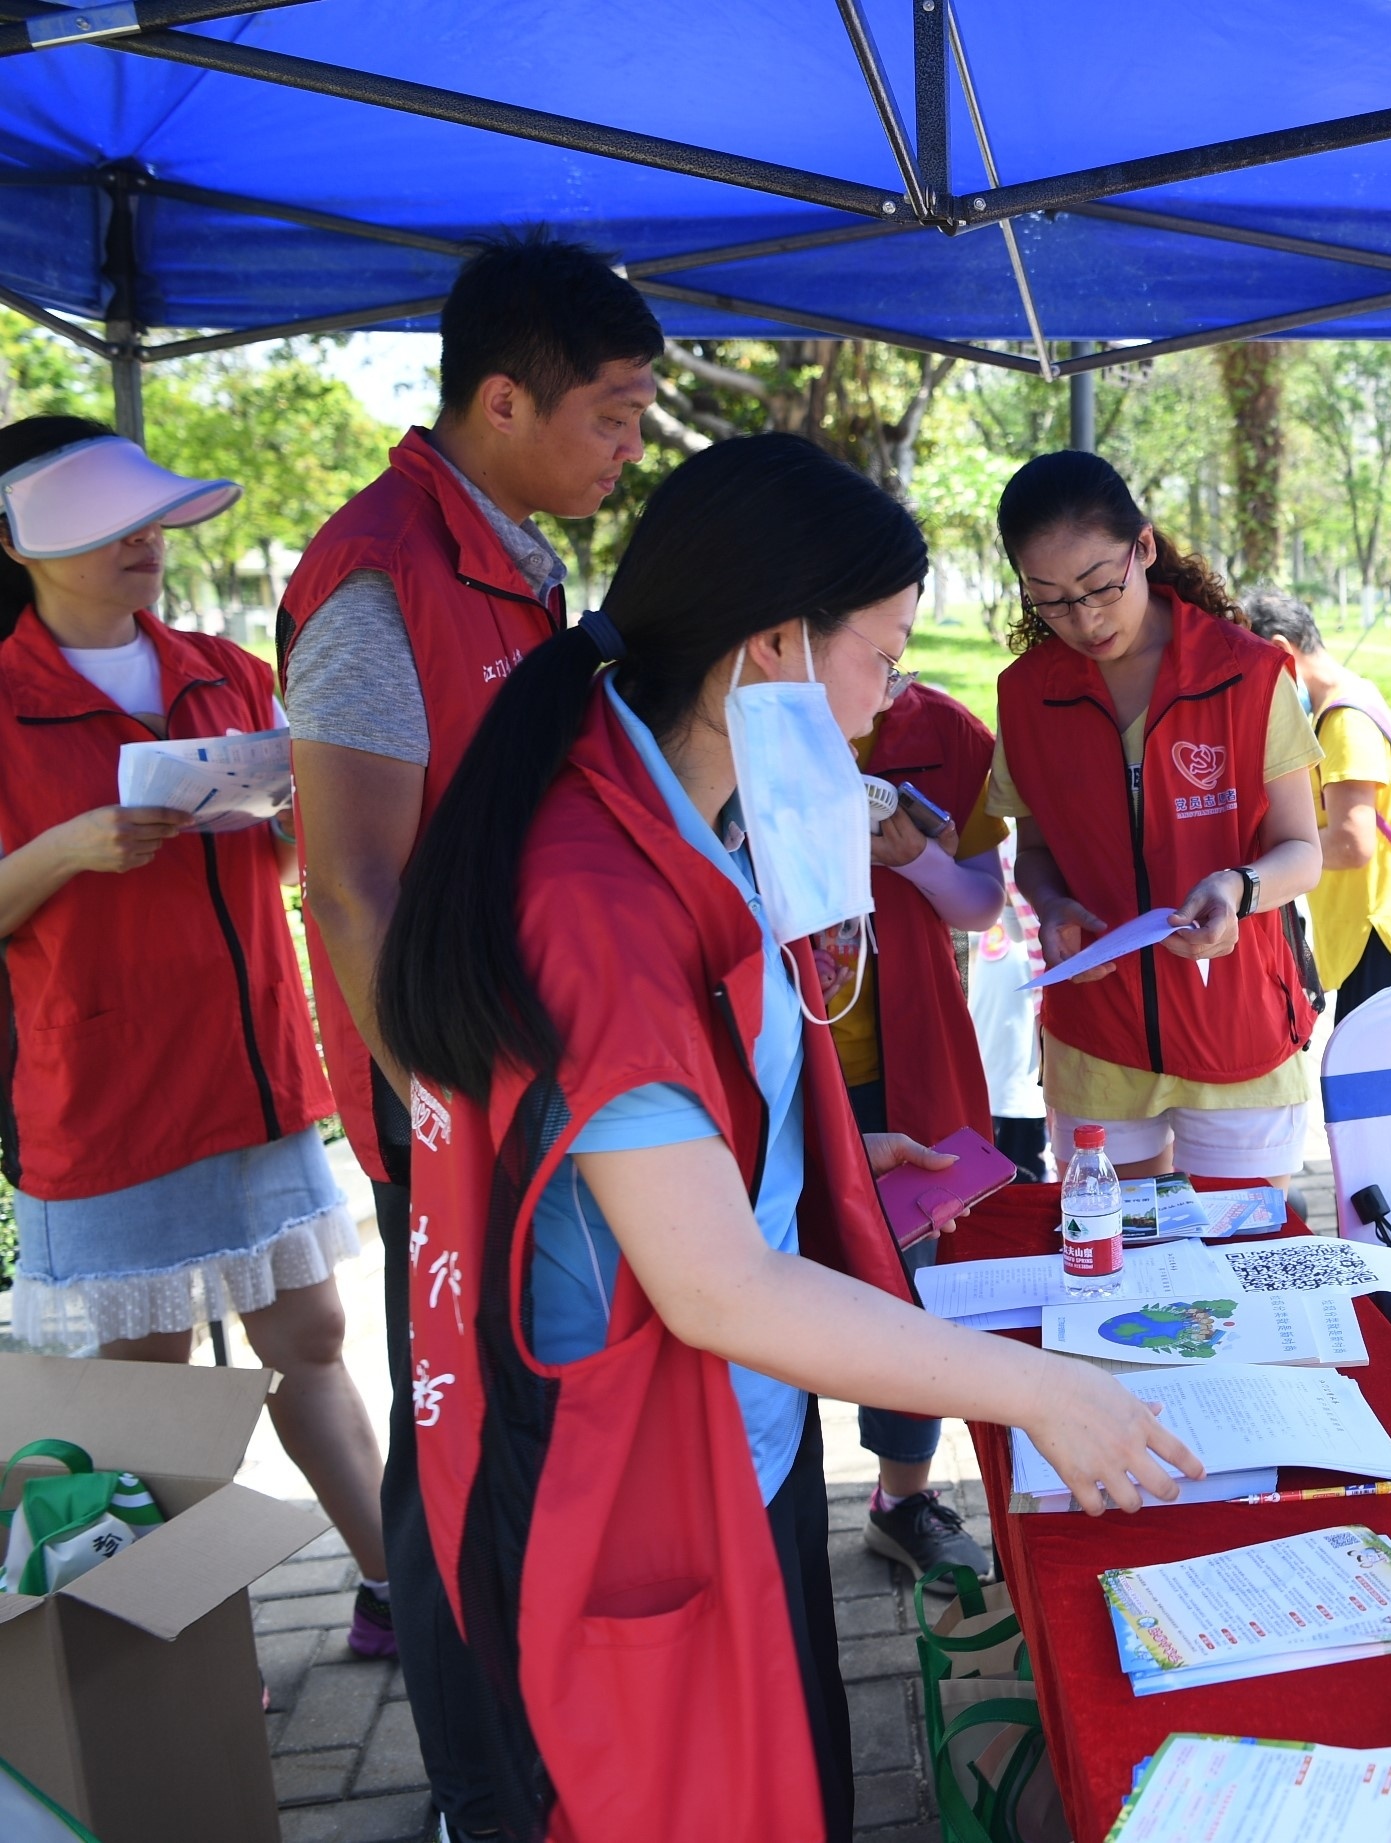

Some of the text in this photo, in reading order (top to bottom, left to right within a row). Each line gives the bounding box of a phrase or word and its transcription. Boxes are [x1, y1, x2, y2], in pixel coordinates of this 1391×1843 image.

[1174, 788, 1238, 812] 党员志愿者
[92, 1532, 123, 1558] 珍
